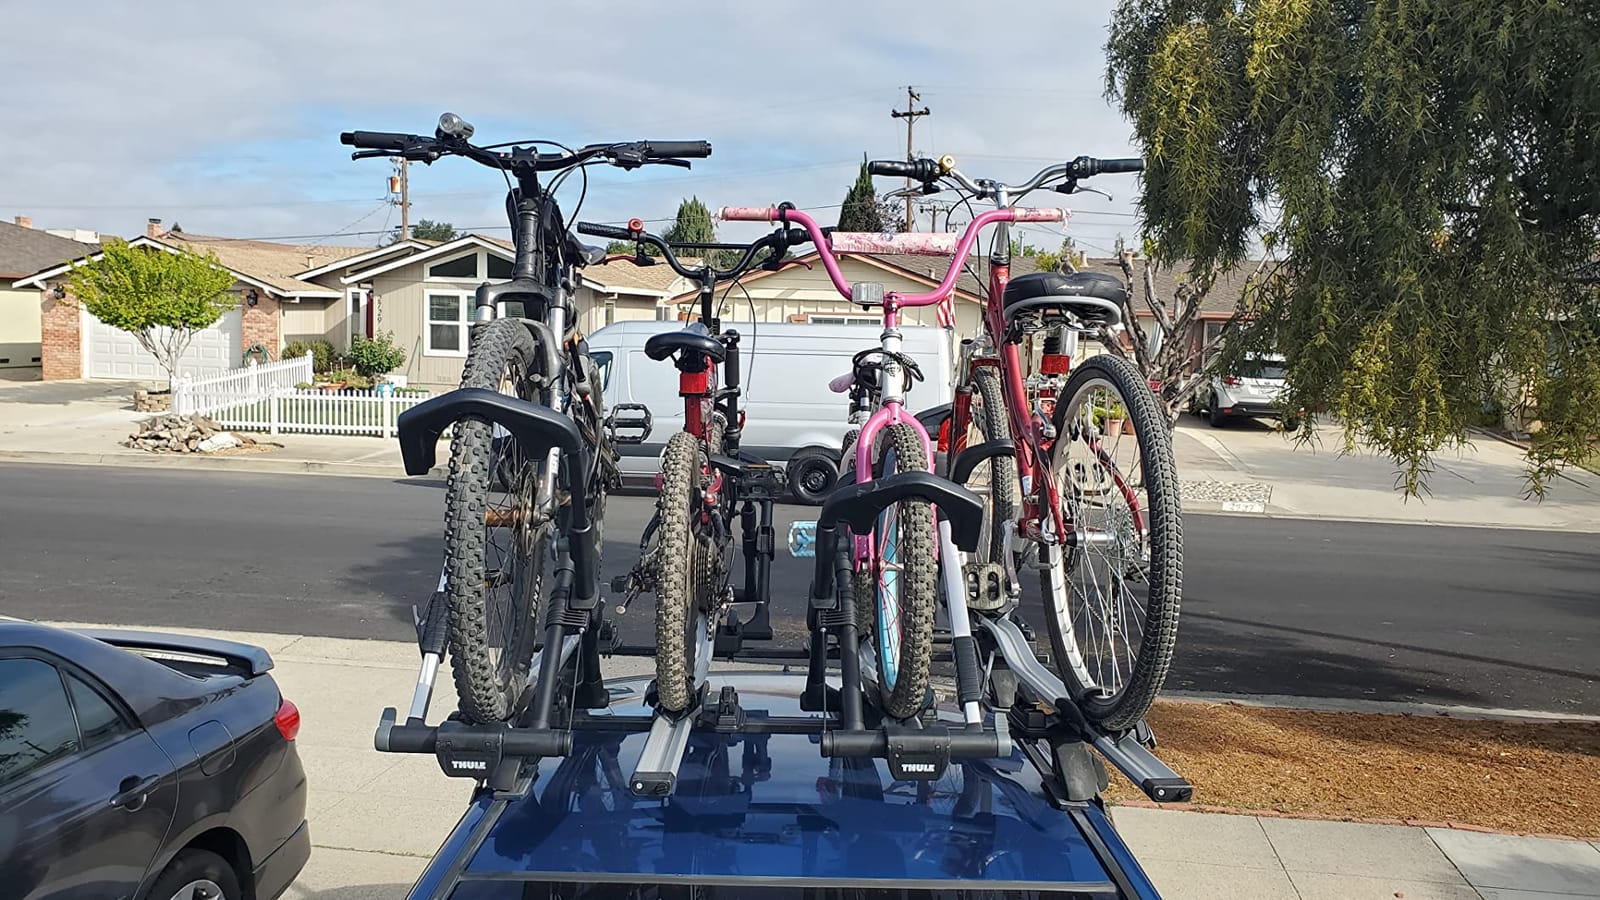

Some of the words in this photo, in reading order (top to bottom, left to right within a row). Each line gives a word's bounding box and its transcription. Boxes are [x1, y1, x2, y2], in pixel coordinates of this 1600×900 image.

[530, 574, 541, 618] KENDA
[451, 760, 487, 770] THULE
[901, 763, 936, 773] THULE
